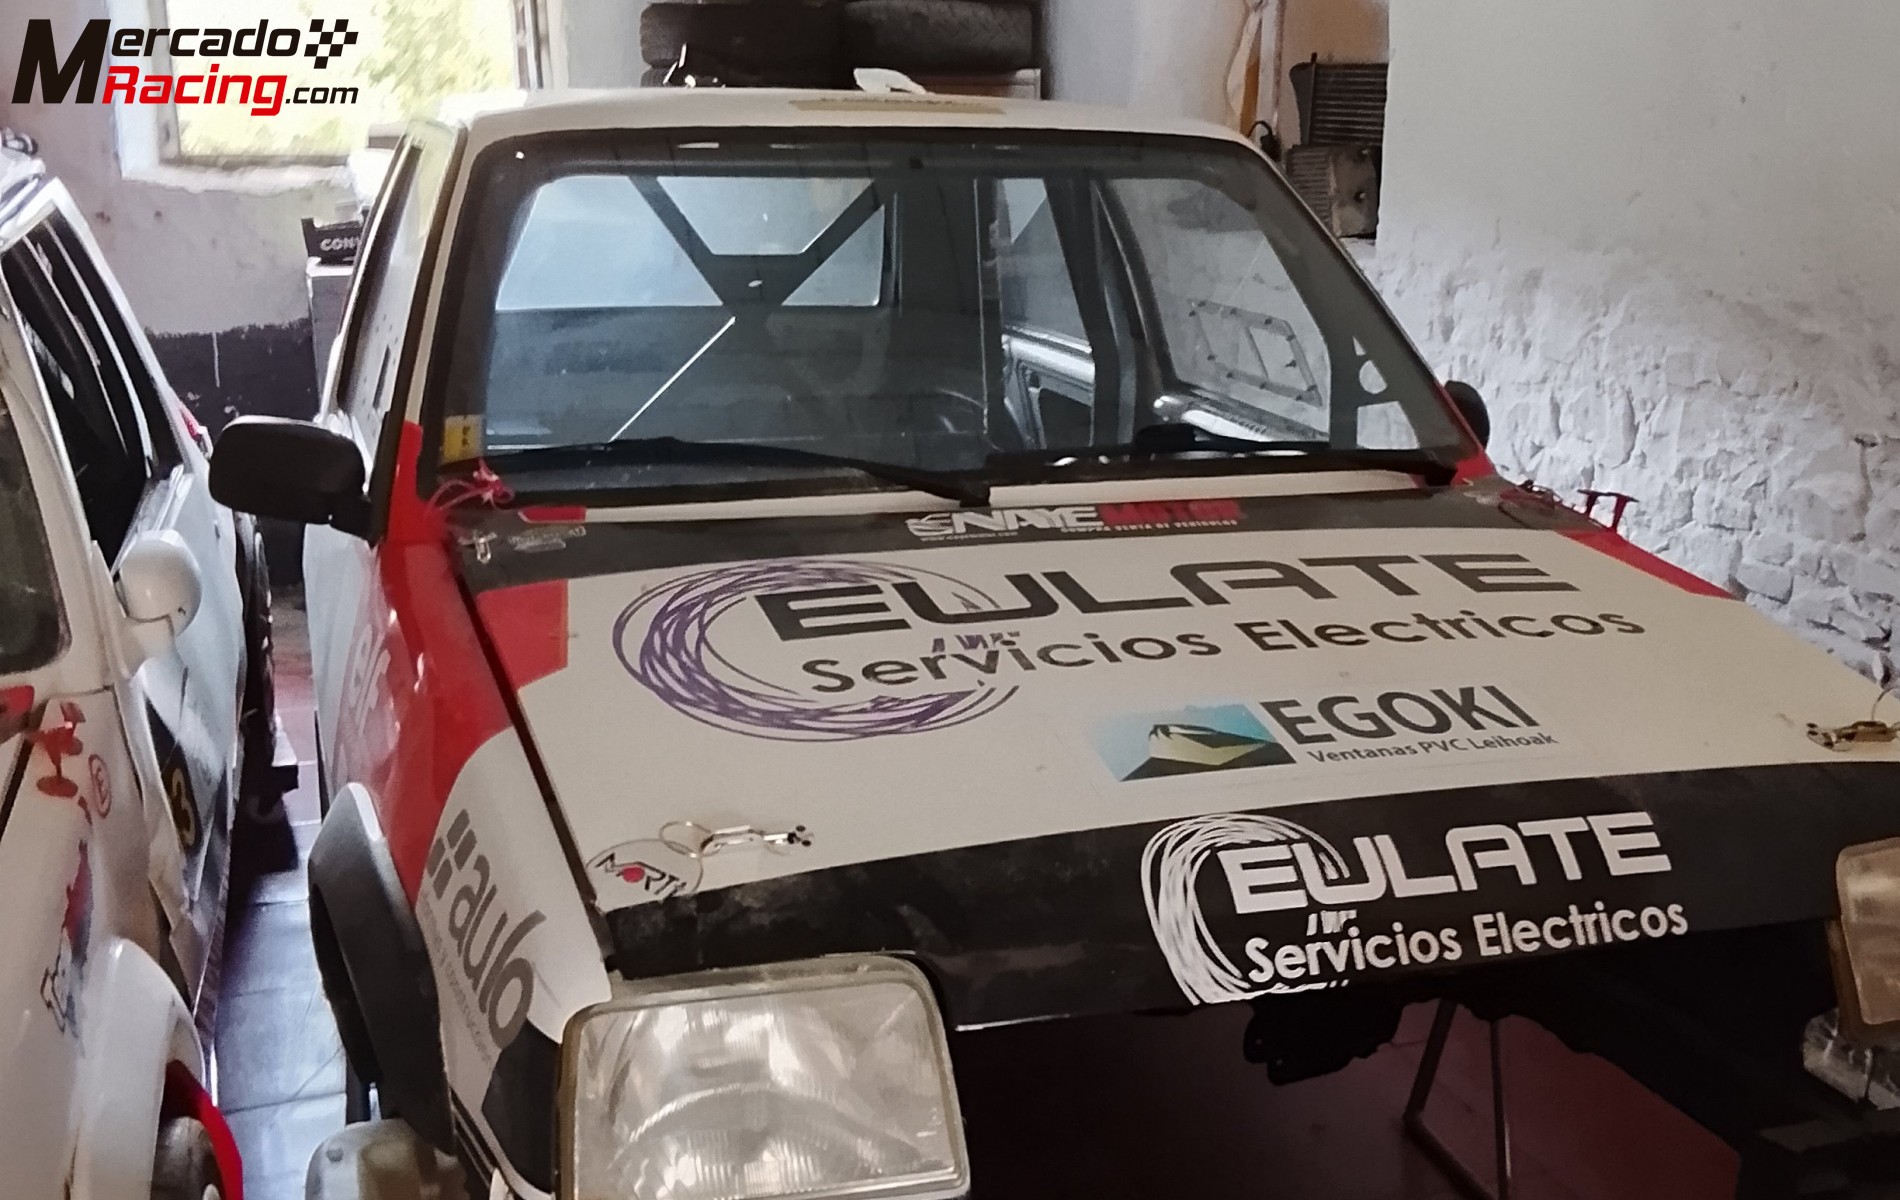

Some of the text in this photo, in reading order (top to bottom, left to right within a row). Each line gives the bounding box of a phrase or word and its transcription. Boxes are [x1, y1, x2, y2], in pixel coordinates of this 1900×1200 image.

[320, 236, 361, 251] CON
[753, 553, 1581, 642] EULATE
[802, 609, 1646, 693] Servicios Electricos
[1259, 685, 1541, 745] EGOKI
[1307, 732, 1559, 763] Ventanas PVC Leihoak
[1217, 811, 1673, 915] EULATE
[1245, 900, 1690, 983] Servicios Electricos
